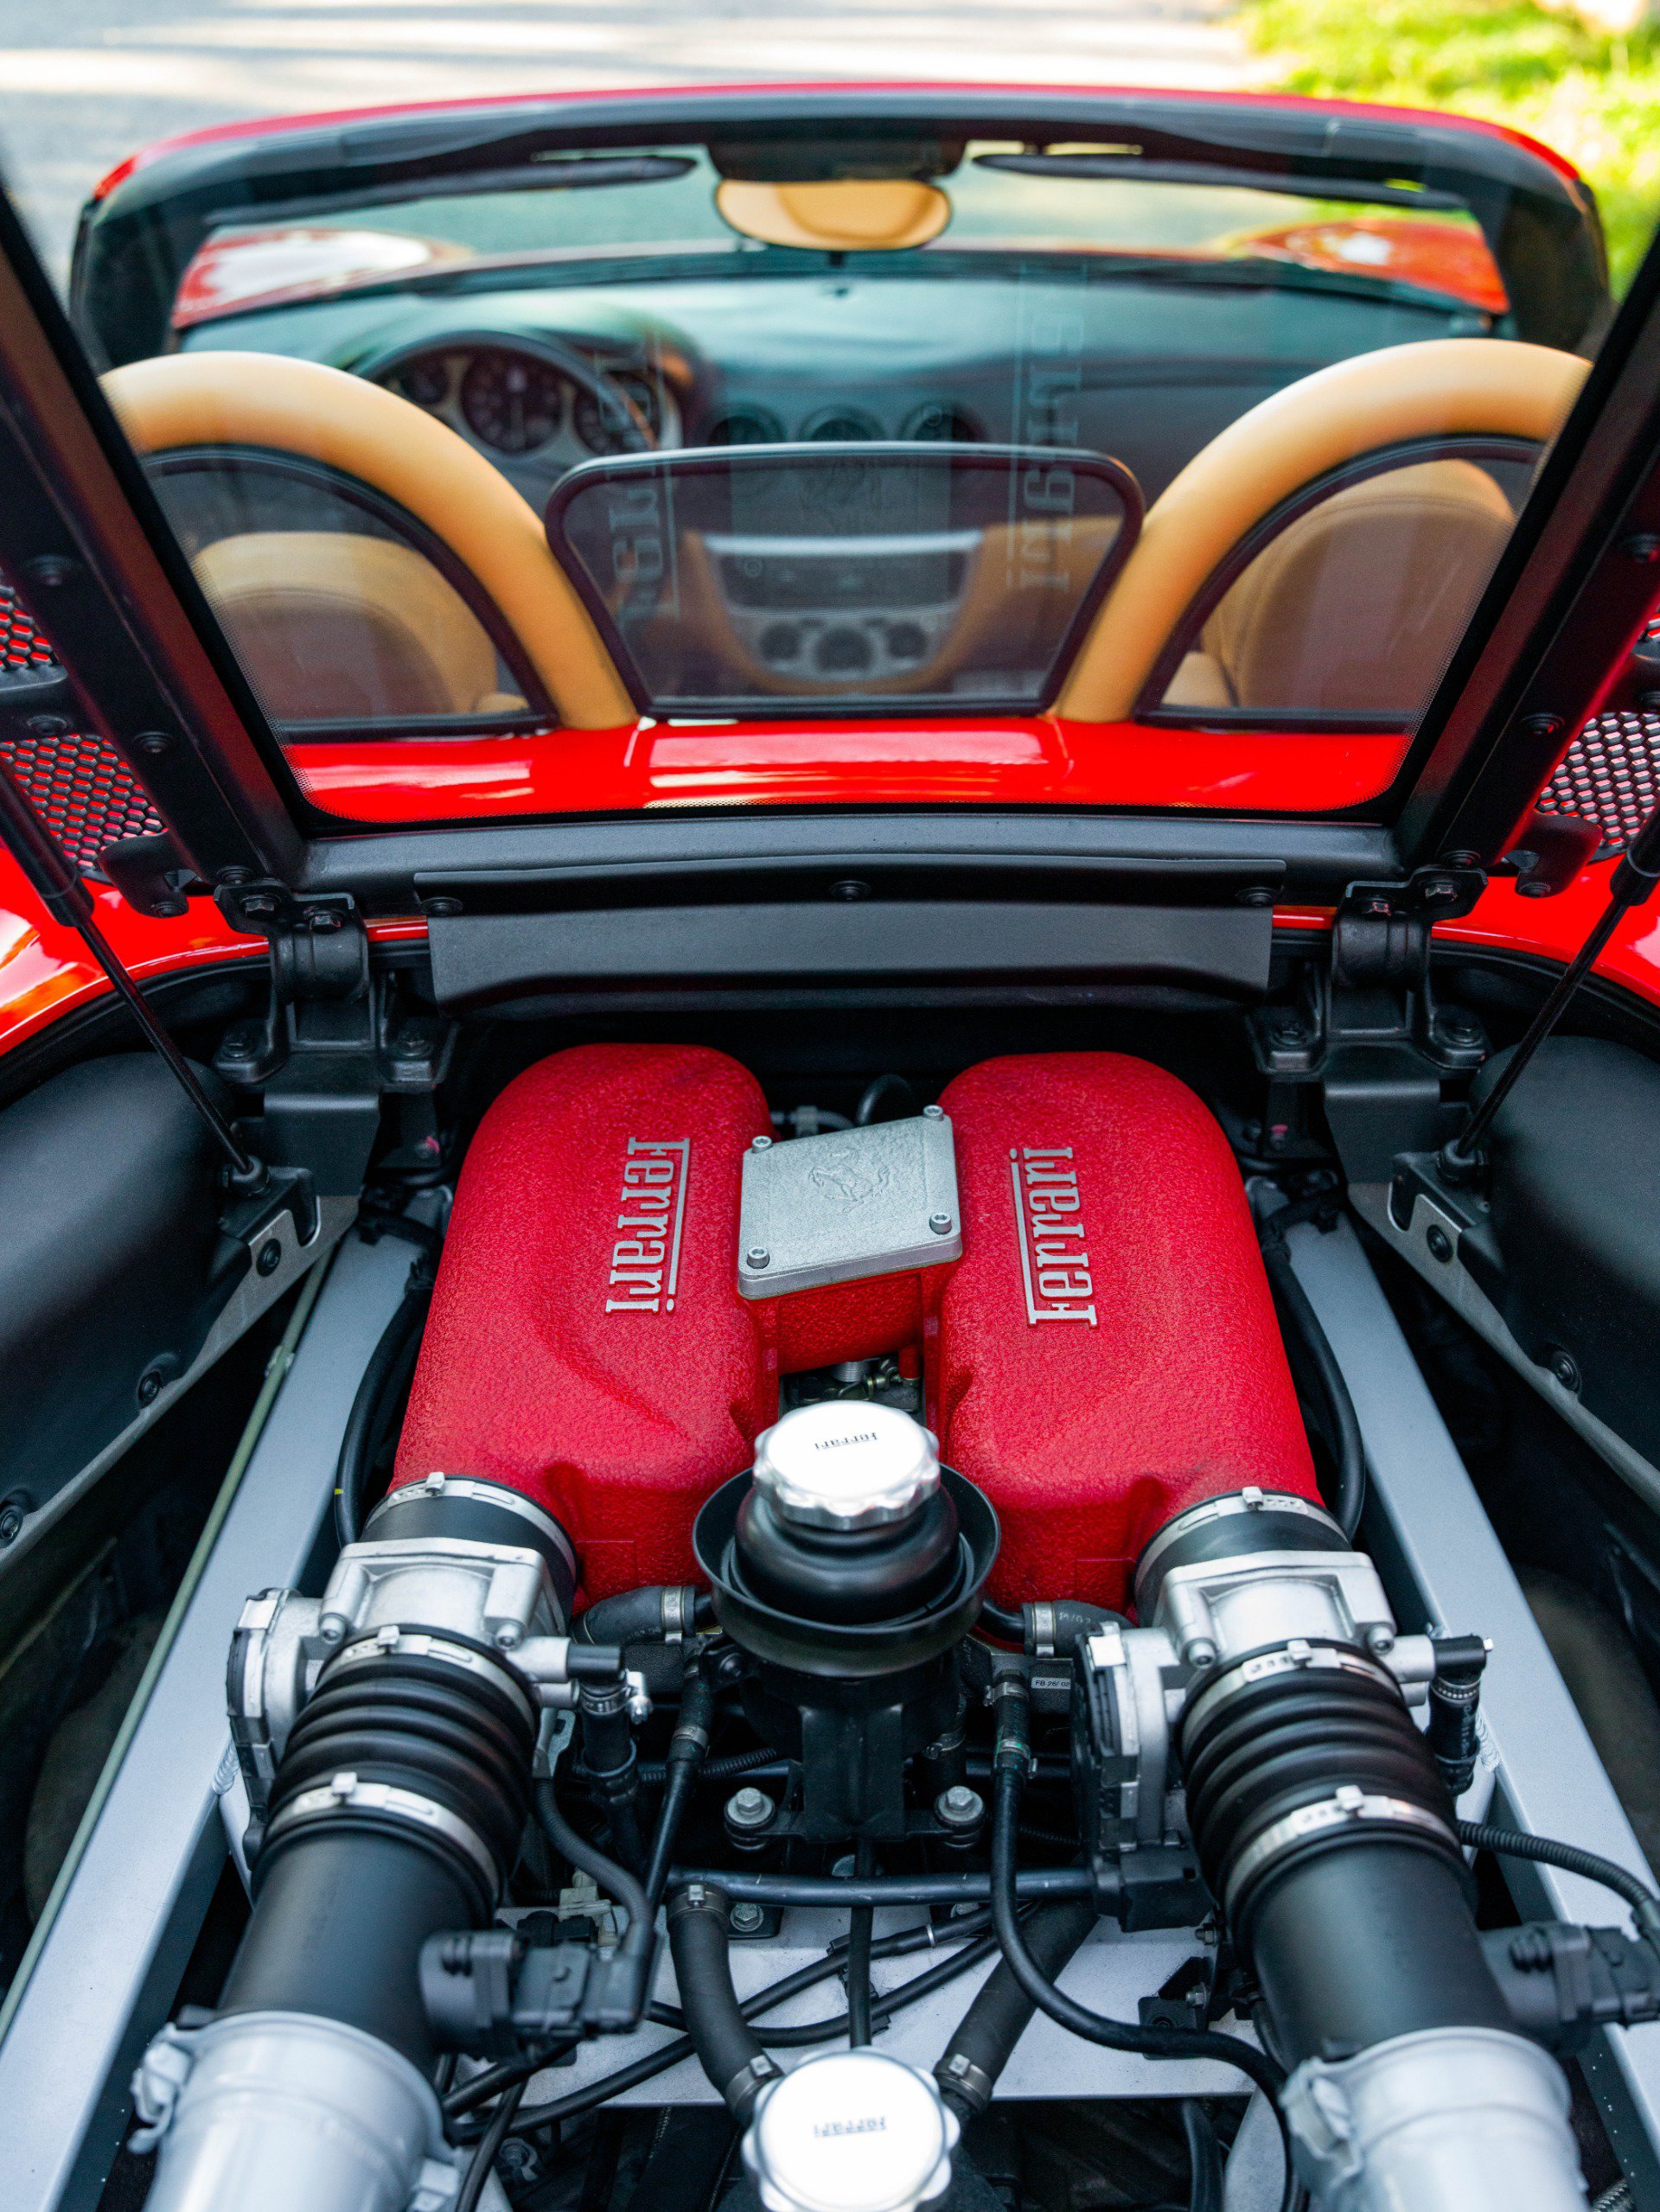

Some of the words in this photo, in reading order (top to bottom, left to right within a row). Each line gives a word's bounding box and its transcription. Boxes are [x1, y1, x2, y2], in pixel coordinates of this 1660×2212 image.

[605, 1137, 690, 1313] Ferrari
[1009, 1146, 1098, 1325] Ferrari
[814, 1431, 878, 1450] Ferrari
[814, 2115, 886, 2138] Ferrari
